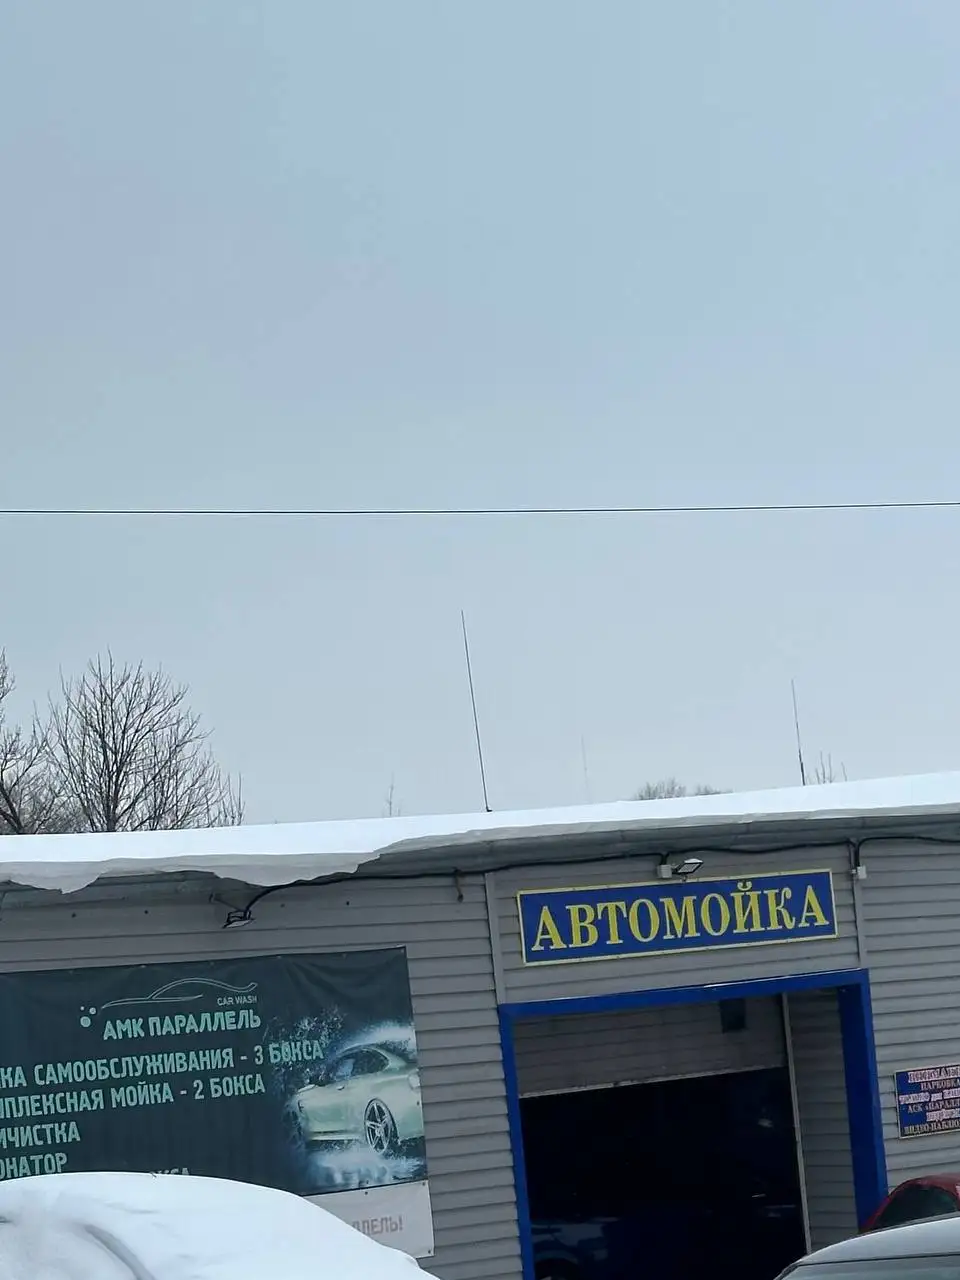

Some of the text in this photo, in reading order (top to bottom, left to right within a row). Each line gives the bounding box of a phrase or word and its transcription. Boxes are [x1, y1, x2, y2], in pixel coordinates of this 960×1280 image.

[531, 880, 830, 951] АВТОМОЙКА
[217, 995, 257, 1006] CAR WASH
[103, 1009, 261, 1040] АМК ПАРАЛЛЕЛЬ
[0, 1066, 27, 1088] КА
[34, 1048, 235, 1086] САМООБСЛУЖИВАНИЯ
[254, 1045, 264, 1065] 3
[268, 1040, 324, 1064] БОКСА
[111, 1081, 174, 1108] МОЙКА
[193, 1079, 204, 1100] 2
[210, 1073, 265, 1098] БОКСА
[921, 1078, 960, 1091] ПАРКОВКА
